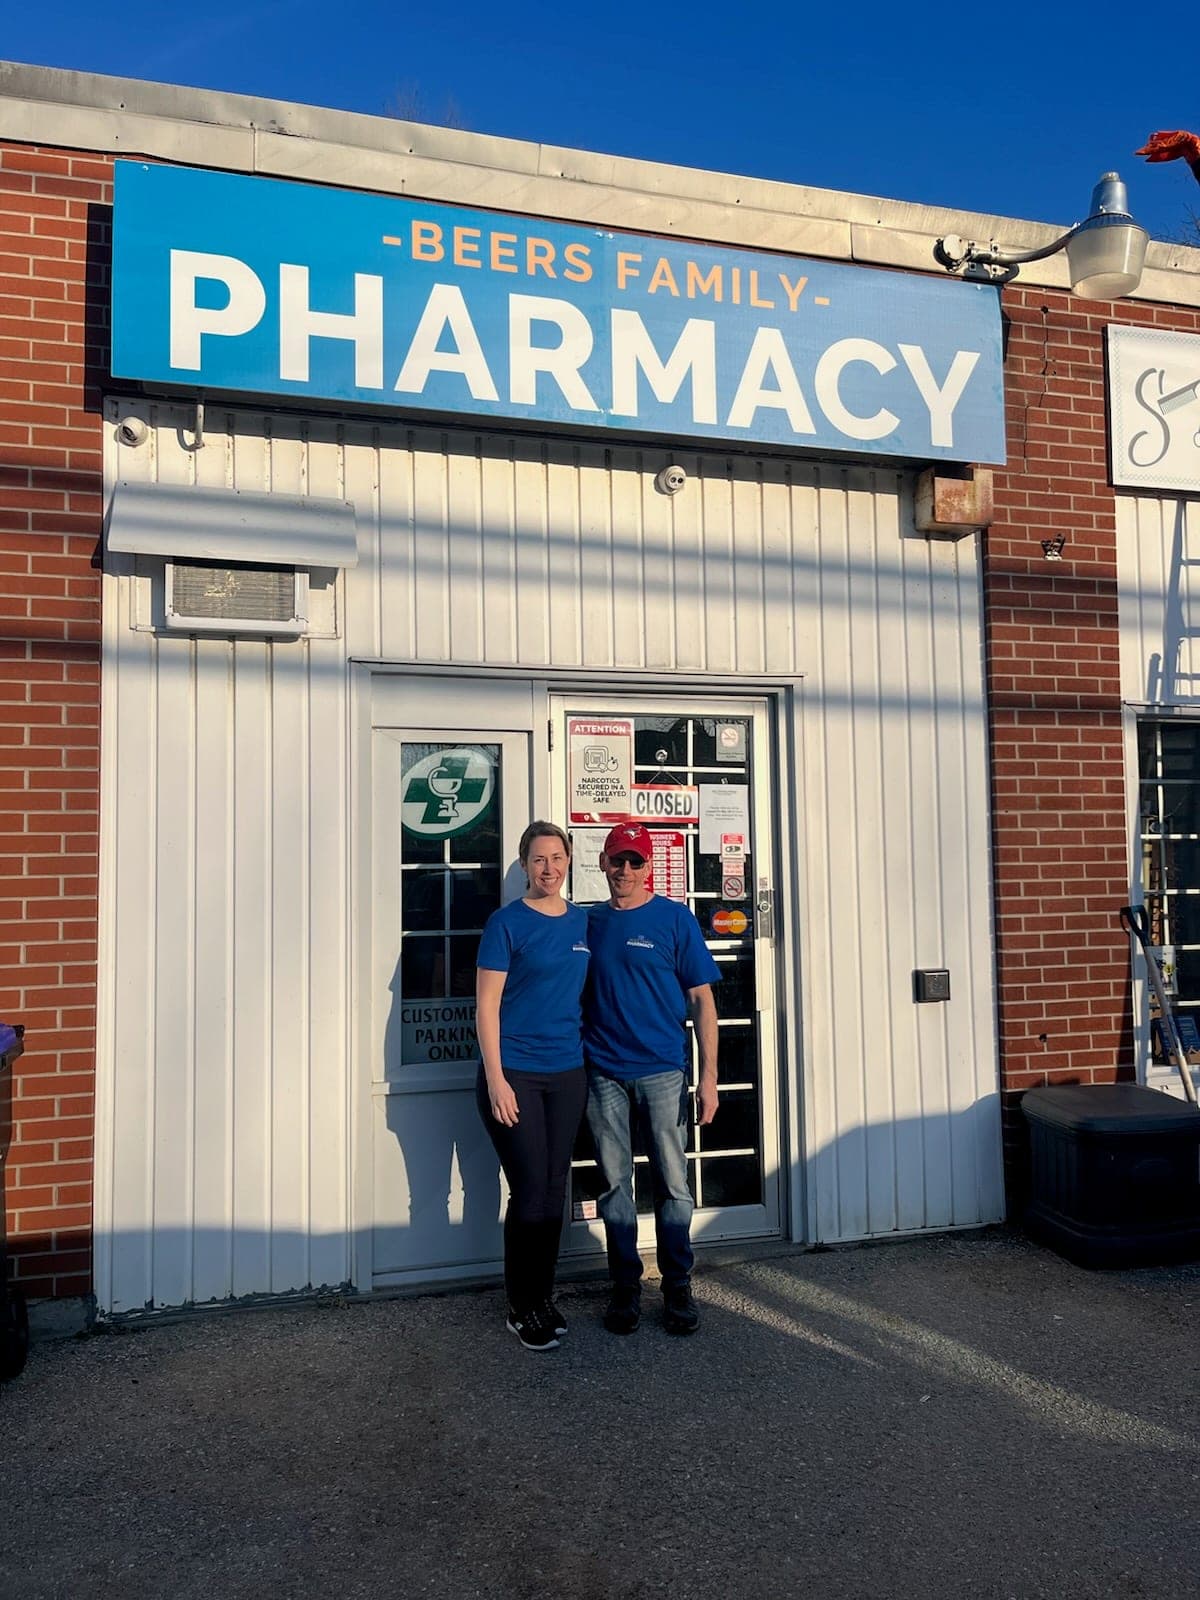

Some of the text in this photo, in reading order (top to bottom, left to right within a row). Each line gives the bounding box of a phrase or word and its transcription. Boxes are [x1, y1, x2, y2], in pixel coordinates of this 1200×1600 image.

[382, 220, 831, 312] -BEERS FAMILY-
[168, 248, 981, 450] PHARMACY
[574, 724, 626, 734] ATTENTION
[636, 791, 693, 816] CLOSED
[401, 1006, 477, 1024] CUSTOME
[415, 1026, 478, 1044] PARKIN
[428, 1043, 474, 1060] ONLY
